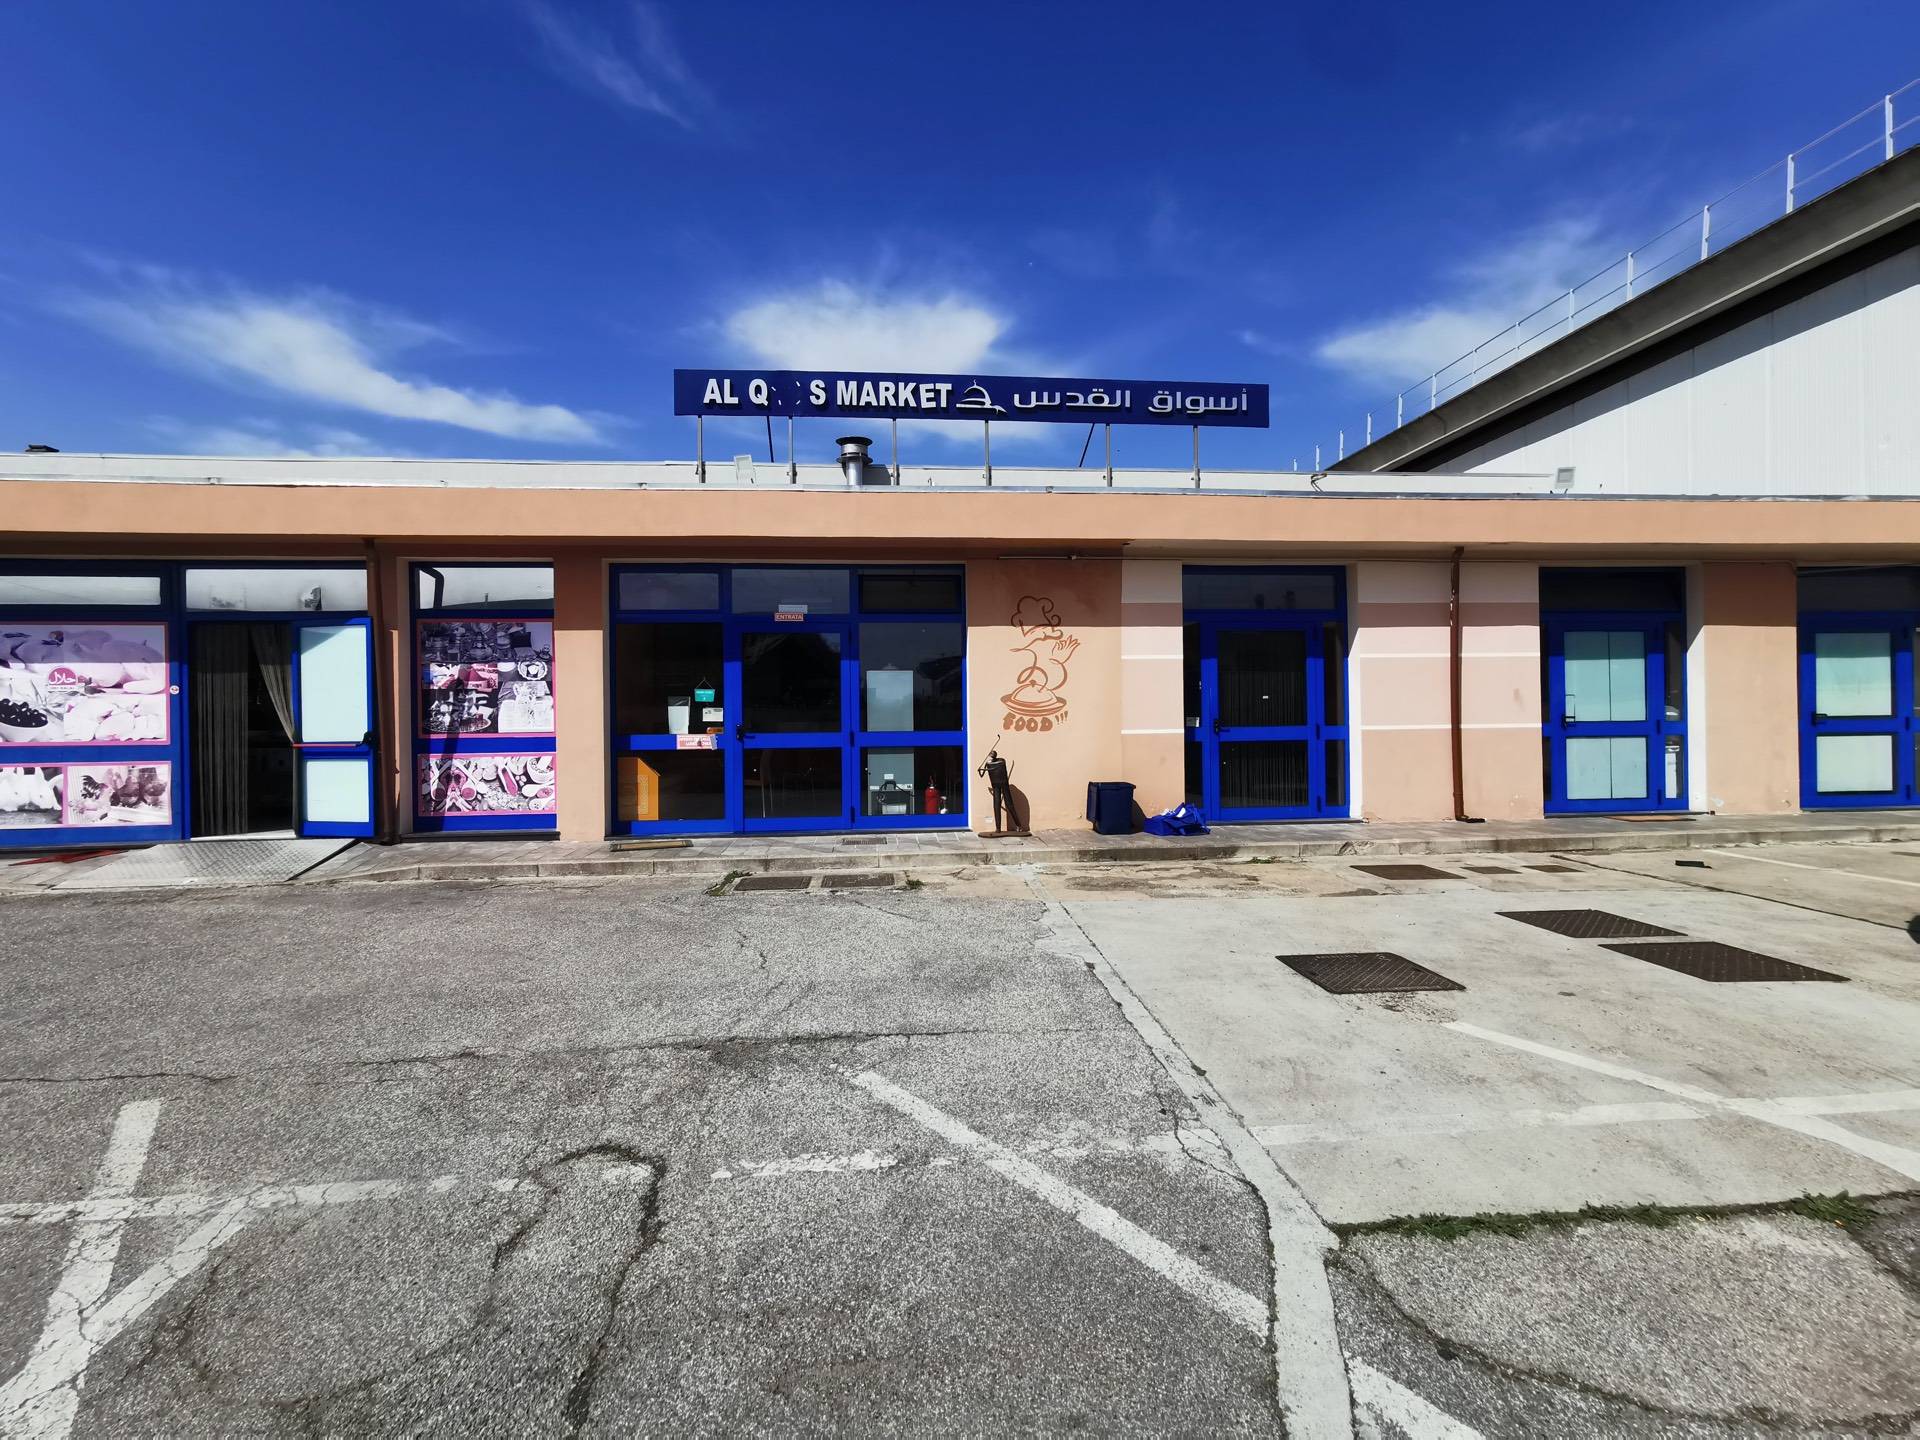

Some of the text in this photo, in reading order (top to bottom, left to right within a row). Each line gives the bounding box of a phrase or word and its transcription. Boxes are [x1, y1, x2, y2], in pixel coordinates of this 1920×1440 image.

[703, 378, 739, 405] AL
[836, 380, 953, 409] MARKET
[1013, 387, 1248, 414] أسواق القدس
